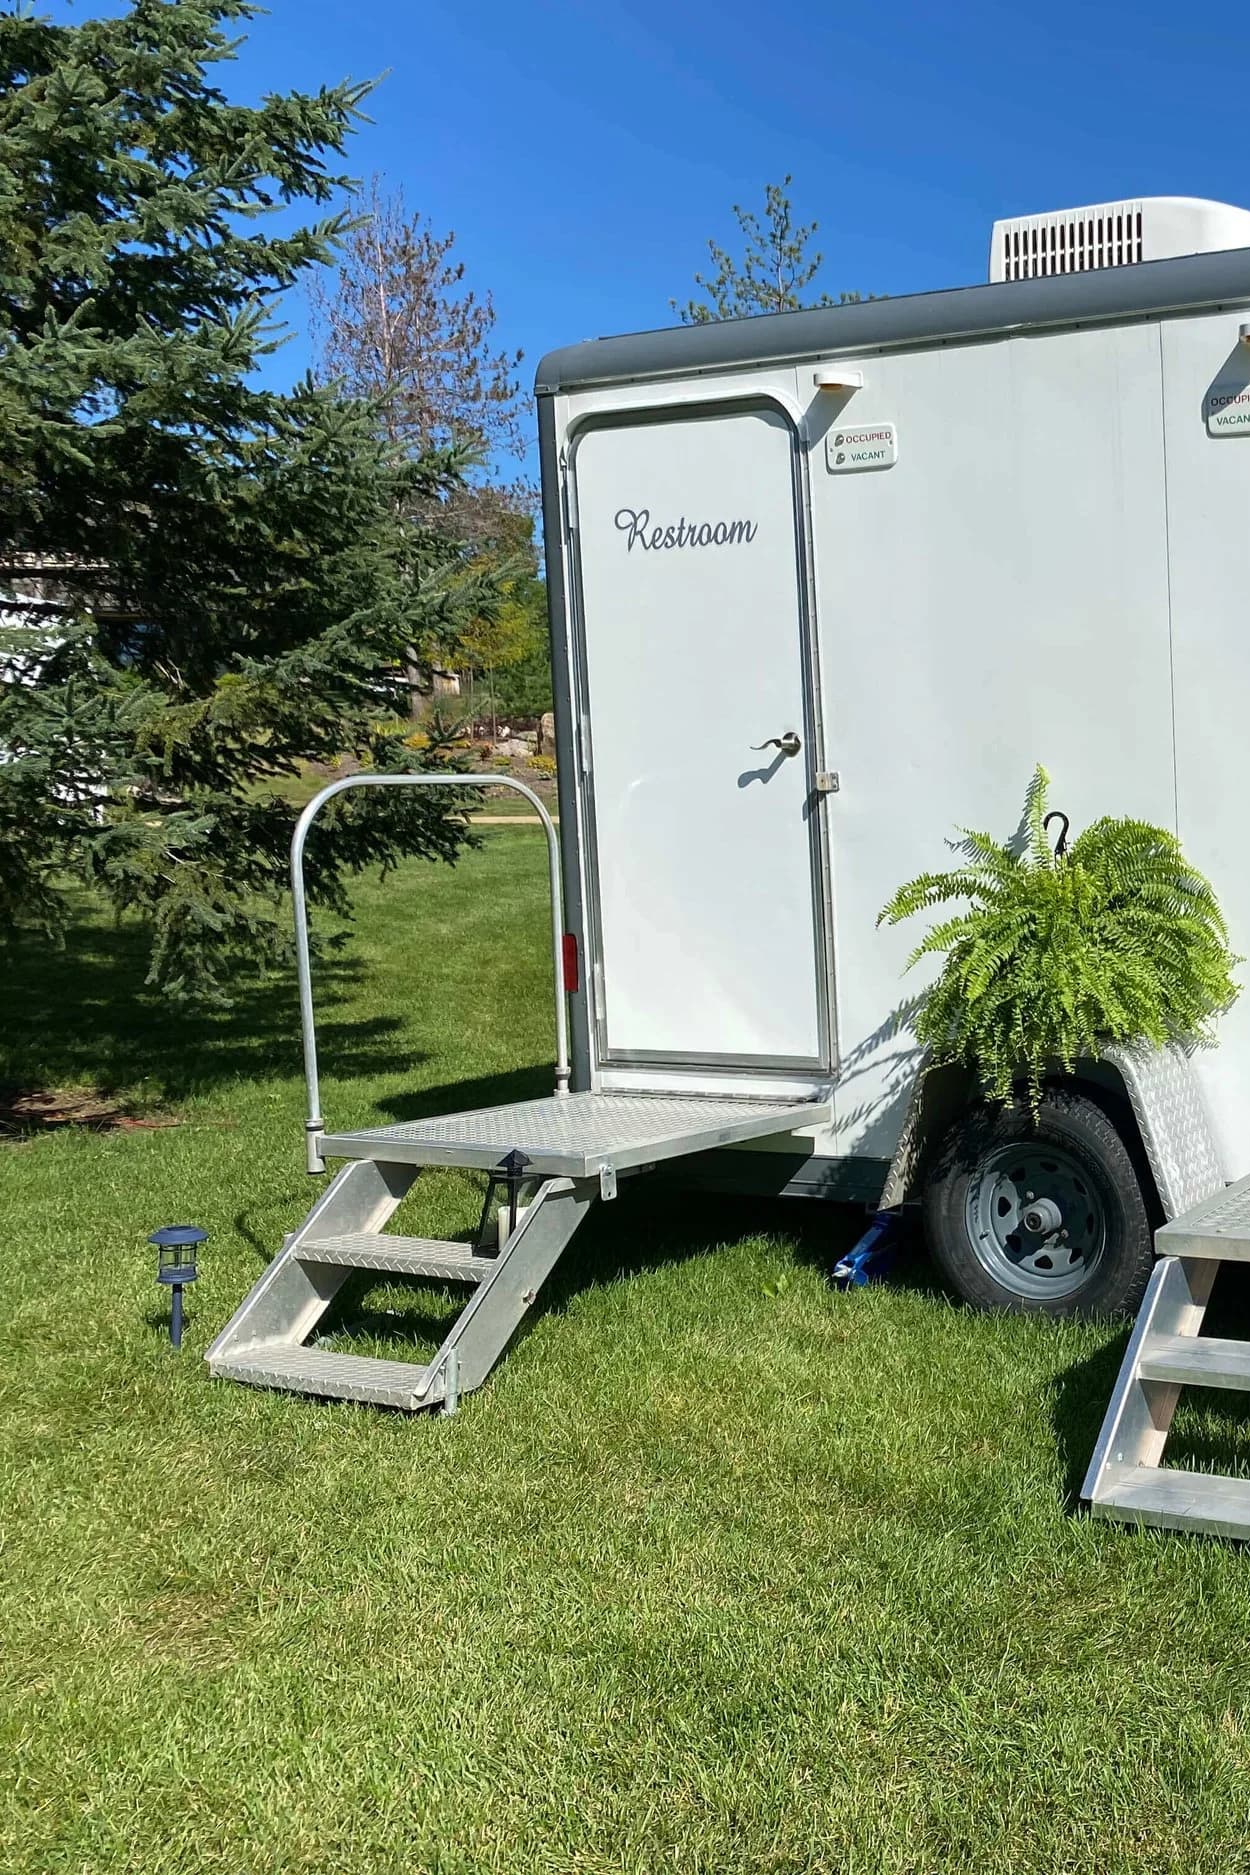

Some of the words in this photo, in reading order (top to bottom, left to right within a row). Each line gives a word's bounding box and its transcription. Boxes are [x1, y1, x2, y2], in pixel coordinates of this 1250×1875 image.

[845, 431, 892, 443] OCCUPIED
[851, 450, 886, 461] VACANT
[614, 508, 758, 552] Restroom
